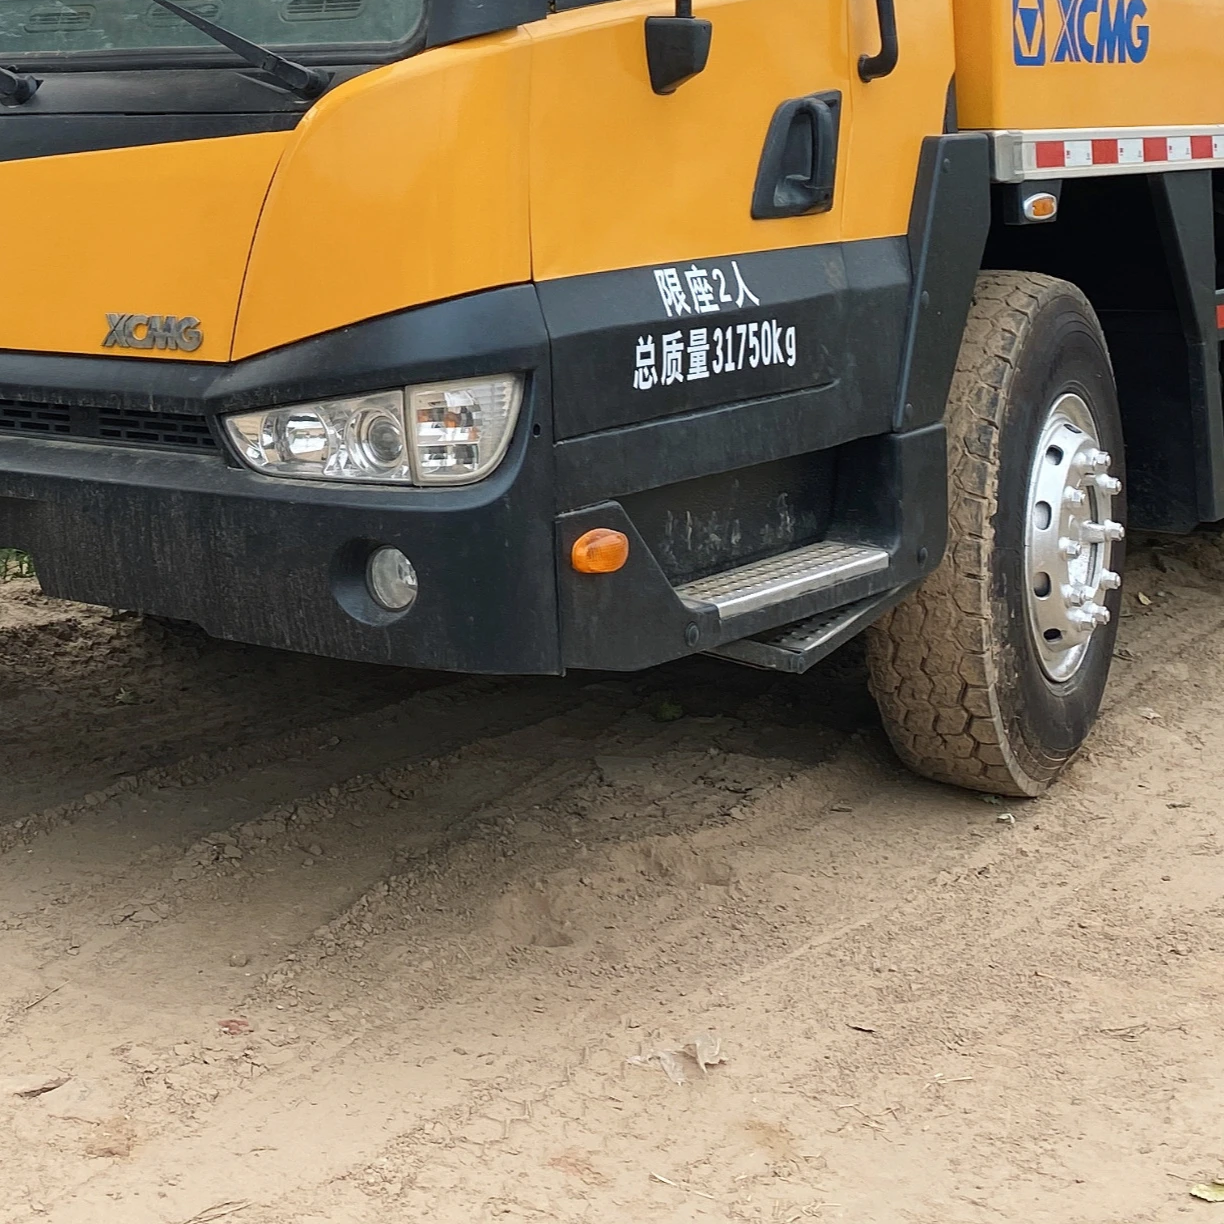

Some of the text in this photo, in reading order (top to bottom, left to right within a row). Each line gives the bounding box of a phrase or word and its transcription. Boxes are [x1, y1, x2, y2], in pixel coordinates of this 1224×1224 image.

[653, 260, 760, 317] 限座2人
[101, 312, 204, 352] XCMG
[633, 319, 796, 390] 总质量31750kg
